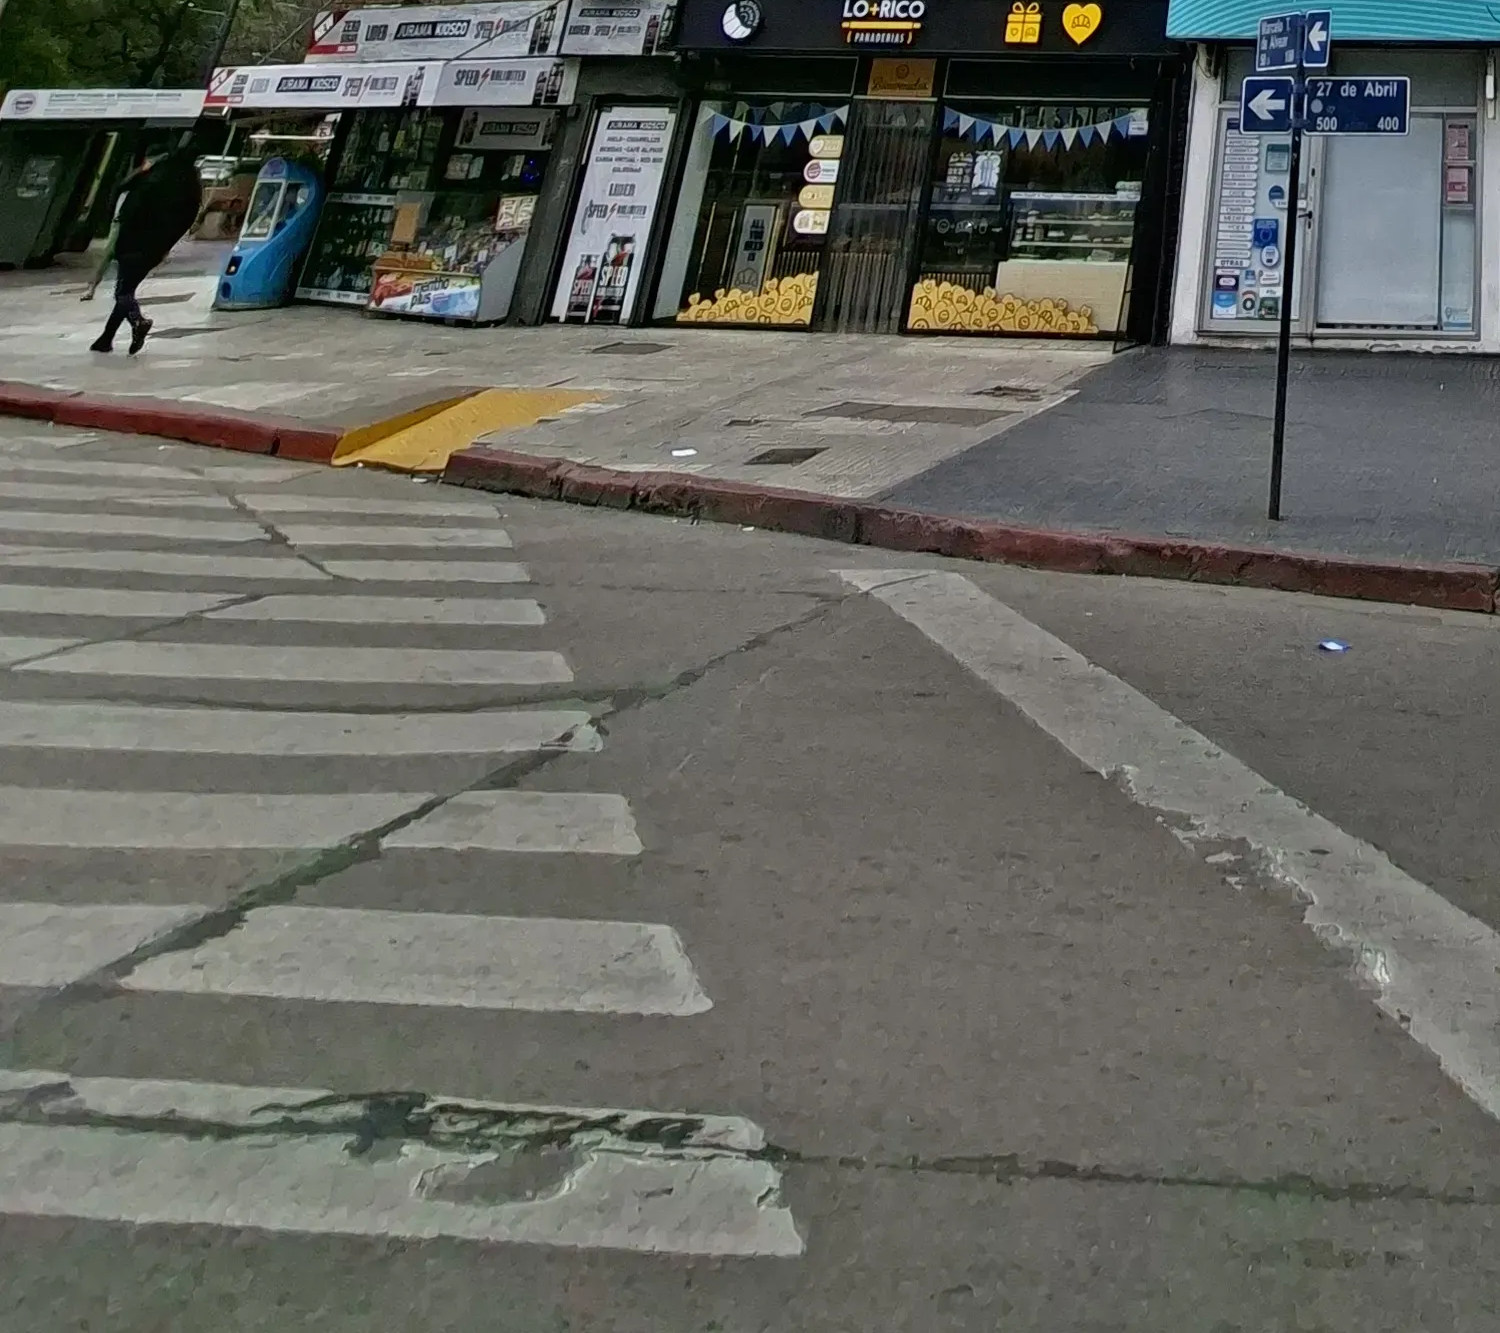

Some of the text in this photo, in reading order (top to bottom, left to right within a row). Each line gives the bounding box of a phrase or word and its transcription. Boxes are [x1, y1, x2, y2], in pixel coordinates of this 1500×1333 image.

[398, 23, 433, 39] JURAMA
[434, 21, 468, 37] KIOSCO
[279, 77, 308, 90] JURAMA
[310, 76, 339, 90] KIOSCO
[1316, 82, 1398, 97] 27 de Abril
[640, 121, 666, 130] KIOSCO
[1316, 117, 1399, 131] 500 400
[608, 183, 636, 196] LIDER
[600, 266, 628, 287] SPEED
[411, 292, 431, 309] plus
